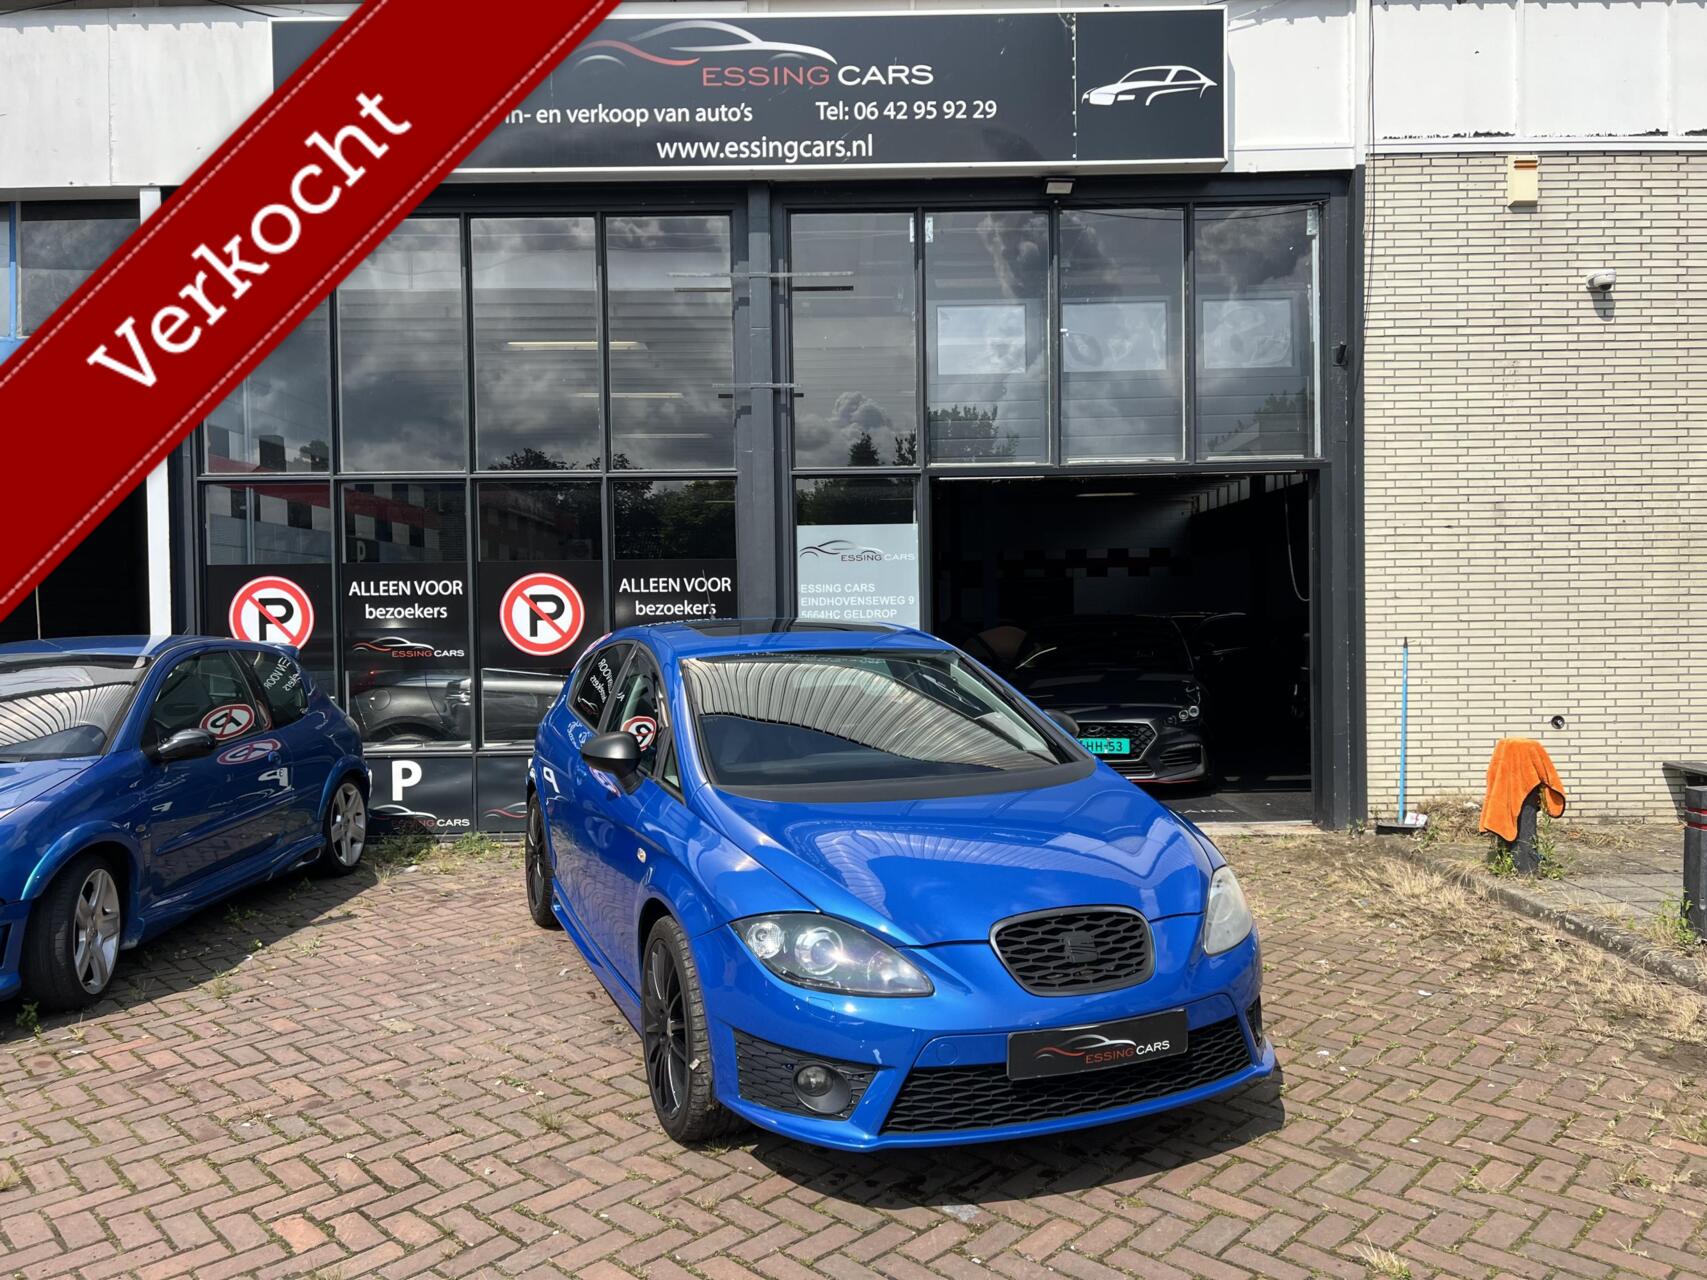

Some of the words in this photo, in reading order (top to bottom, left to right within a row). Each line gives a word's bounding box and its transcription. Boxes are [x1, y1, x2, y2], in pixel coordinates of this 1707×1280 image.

[702, 66, 830, 87] ESSING
[837, 64, 935, 86] CARS
[536, 108, 561, 124] en
[566, 103, 649, 127] verkoop
[654, 106, 690, 122] van
[695, 102, 753, 122] auto's
[815, 101, 849, 121] Tel:
[854, 101, 879, 120] 06
[883, 101, 908, 120] 42
[913, 101, 938, 120] 95
[943, 101, 967, 119] 92
[972, 100, 997, 119] 29
[656, 133, 873, 163] www.essingcars.nl
[841, 554, 882, 562] ESSING
[884, 553, 915, 561] CARS
[348, 580, 411, 596] ALLEEN
[414, 580, 463, 595] VOOR
[619, 577, 680, 593] ALLEEN
[683, 577, 732, 592] VOOR
[800, 583, 842, 594] ESSING
[845, 583, 876, 593] CARS
[635, 600, 717, 616] bezoekers
[800, 595, 906, 606] EINDHOVENSEWEG
[908, 596, 915, 605] 9
[365, 603, 448, 619] bezoekers
[843, 609, 898, 619] GELDROP
[392, 650, 432, 658] ESSING
[434, 649, 465, 657] CARS
[391, 760, 423, 801] P
[436, 818, 471, 827] CARS
[1085, 1047, 1136, 1064] ESSING
[1136, 1040, 1170, 1055] CARS
